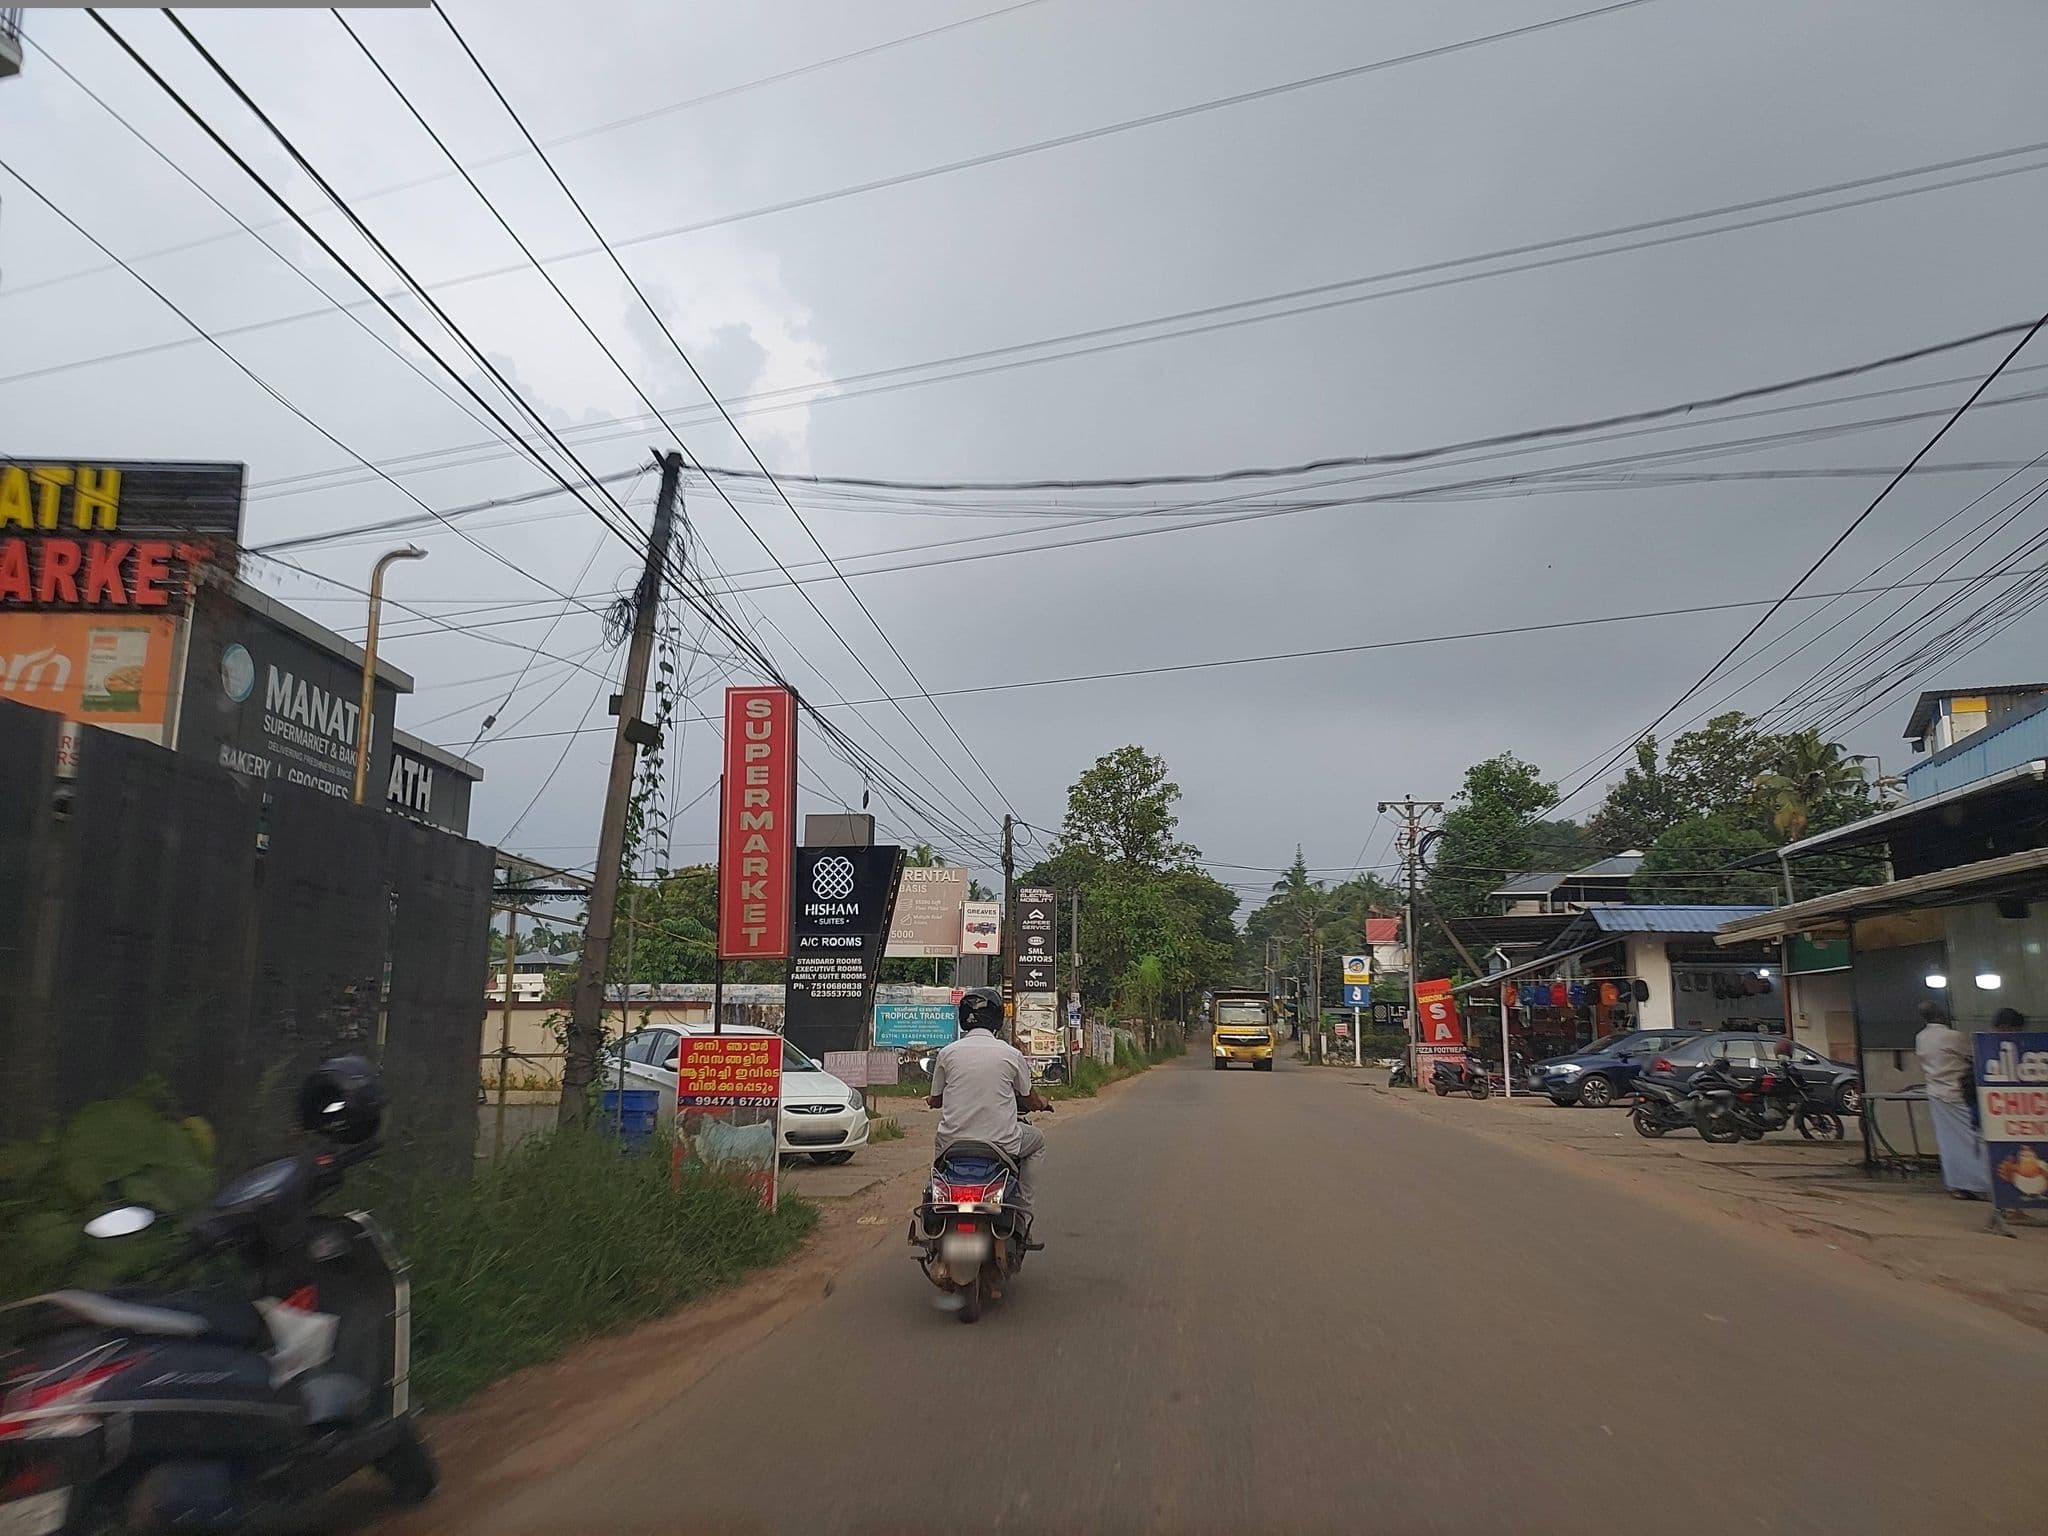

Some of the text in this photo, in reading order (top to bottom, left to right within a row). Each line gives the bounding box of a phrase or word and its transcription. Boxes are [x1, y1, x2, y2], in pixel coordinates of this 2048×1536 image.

[0, 466, 121, 530] ATH
[263, 714, 329, 756] SUPERMARKET
[331, 742, 338, 760] &
[219, 743, 272, 780] BAKERY
[387, 754, 433, 813] ATH
[739, 698, 773, 947] SUPERMARKET
[903, 869, 960, 883] RENTAL
[899, 884, 928, 893] BASIS
[805, 903, 859, 916] HISHAM
[818, 917, 845, 925] SUITES
[800, 937, 862, 947] A/C ROOMS
[1028, 947, 1045, 955] SML
[1019, 955, 1053, 963] MOTORS
[795, 965, 863, 973] EXECUTIVE ROOMS
[811, 982, 862, 990] 7510680838
[1025, 980, 1047, 988] 100m
[811, 990, 862, 998] 6235537300
[881, 1012, 955, 1020] TROPICAL TRADERS
[695, 1096, 778, 1106] 99474 67207
